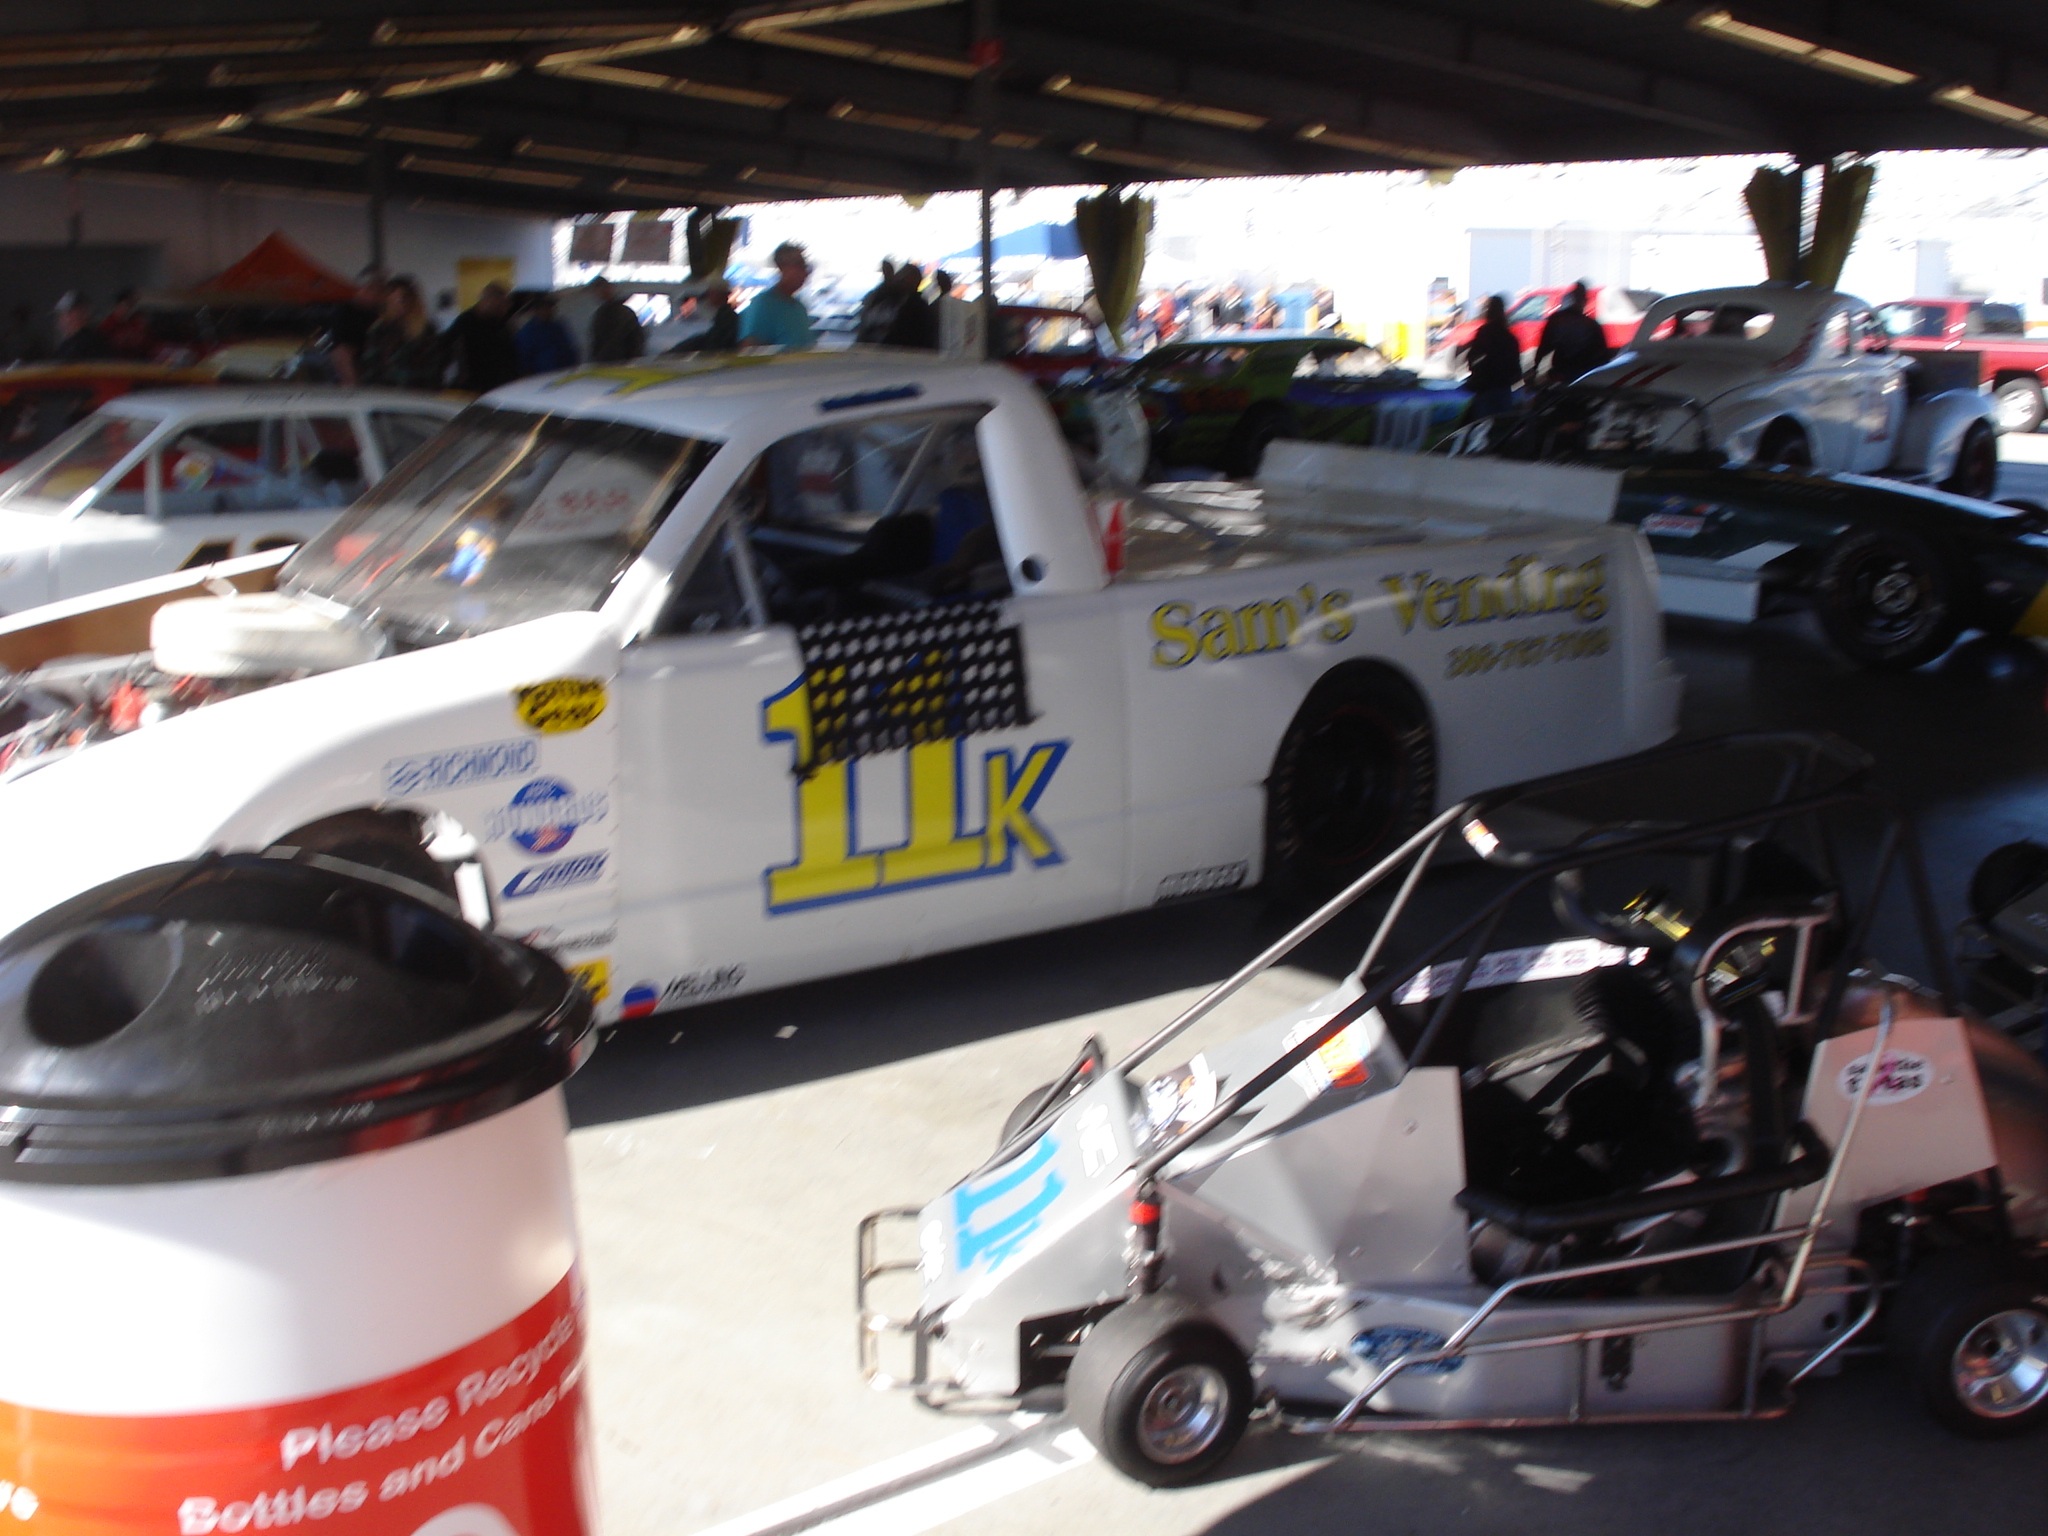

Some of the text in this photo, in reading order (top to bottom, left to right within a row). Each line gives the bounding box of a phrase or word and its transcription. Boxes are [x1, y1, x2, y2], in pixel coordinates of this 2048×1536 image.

[1150, 554, 1610, 669] Sam's Vending
[177, 1385, 558, 1536] Bottles and Cans
[280, 1395, 451, 1471] Please
[454, 1314, 575, 1417] Recycle
